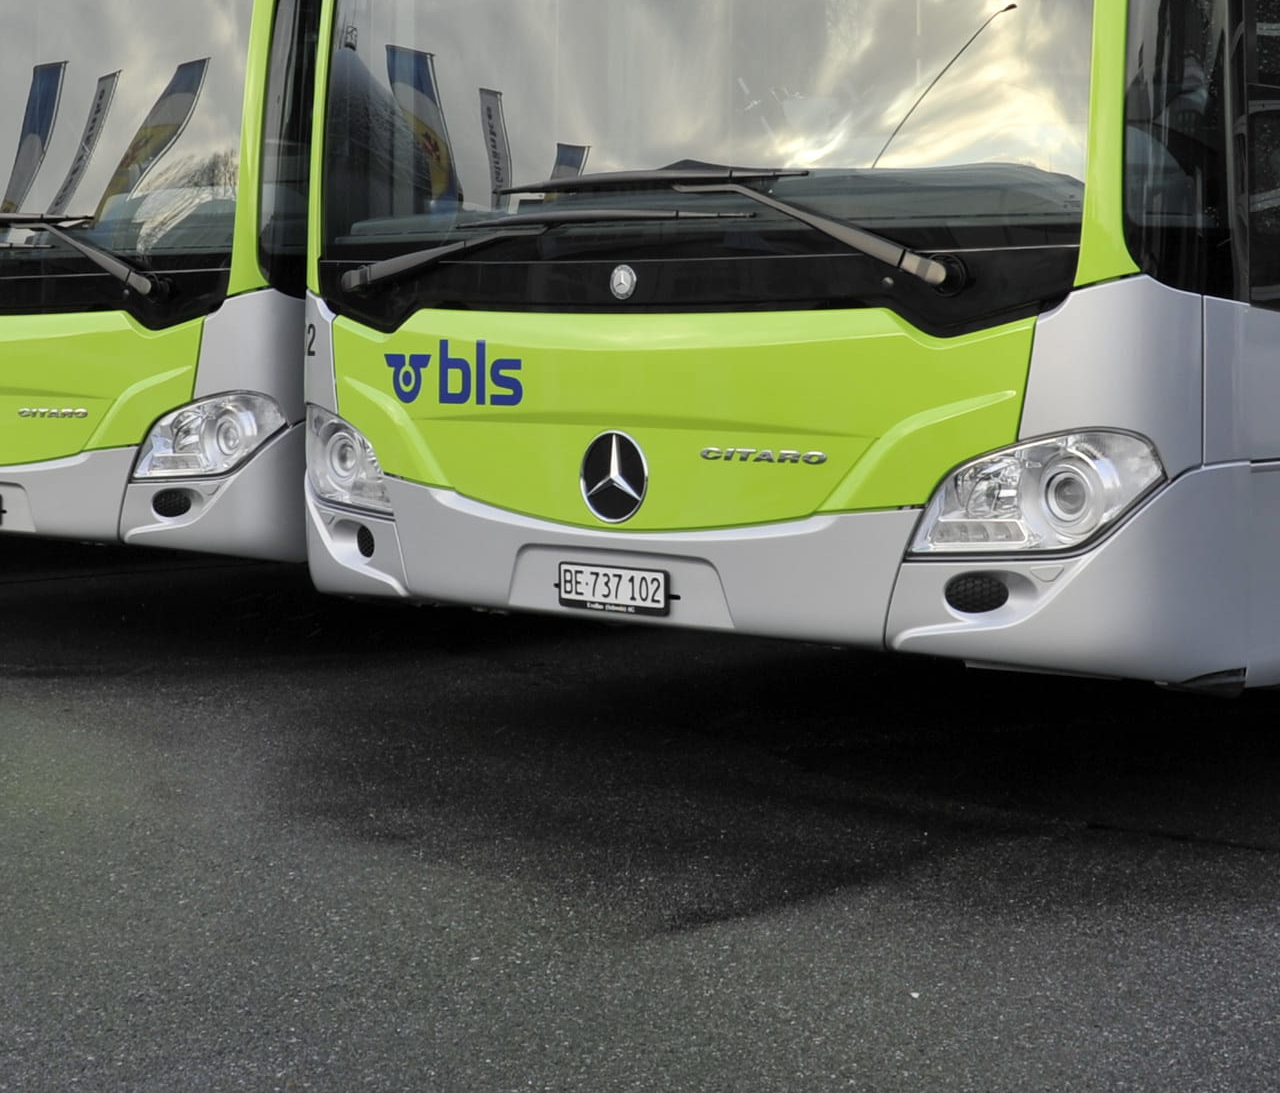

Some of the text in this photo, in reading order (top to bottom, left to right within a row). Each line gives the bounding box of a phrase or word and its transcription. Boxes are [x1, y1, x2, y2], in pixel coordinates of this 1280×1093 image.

[439, 339, 523, 406] bls
[18, 408, 89, 419] CITARO
[700, 447, 828, 465] CITARO
